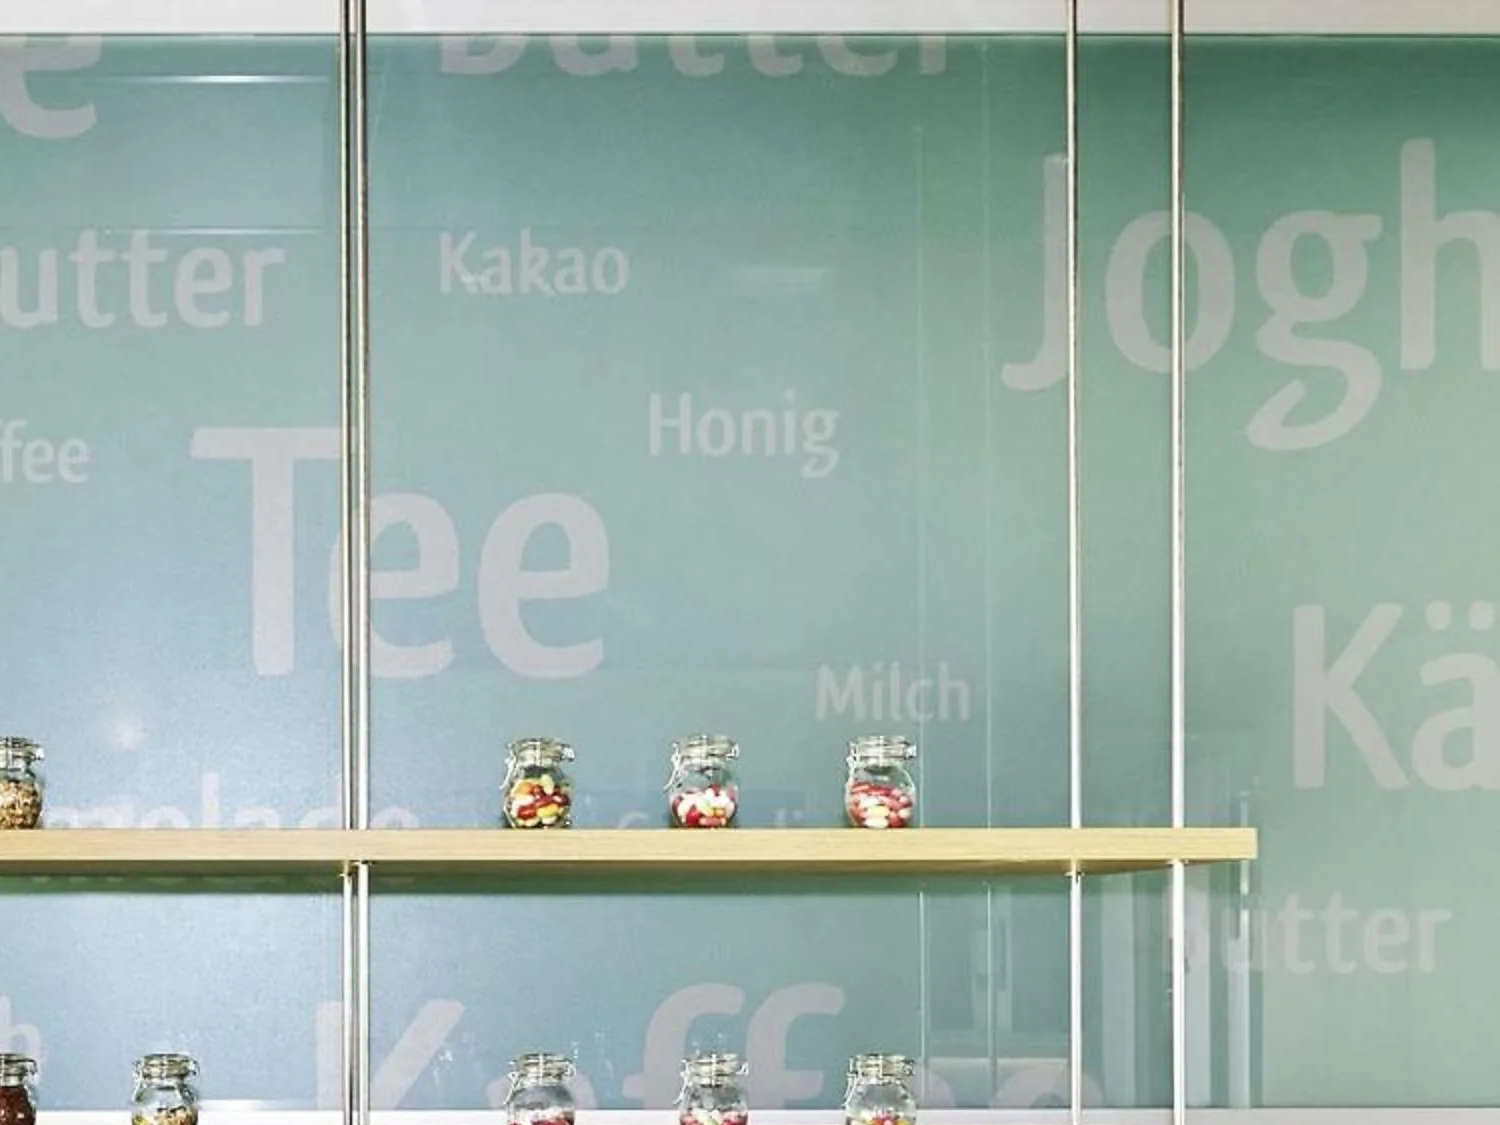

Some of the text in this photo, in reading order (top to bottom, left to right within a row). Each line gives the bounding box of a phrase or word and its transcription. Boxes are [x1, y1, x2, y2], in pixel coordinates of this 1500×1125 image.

[440, 227, 630, 297] Kakao
[647, 388, 841, 478] Honig
[191, 427, 612, 680] Tee
[815, 660, 972, 724] Milch
